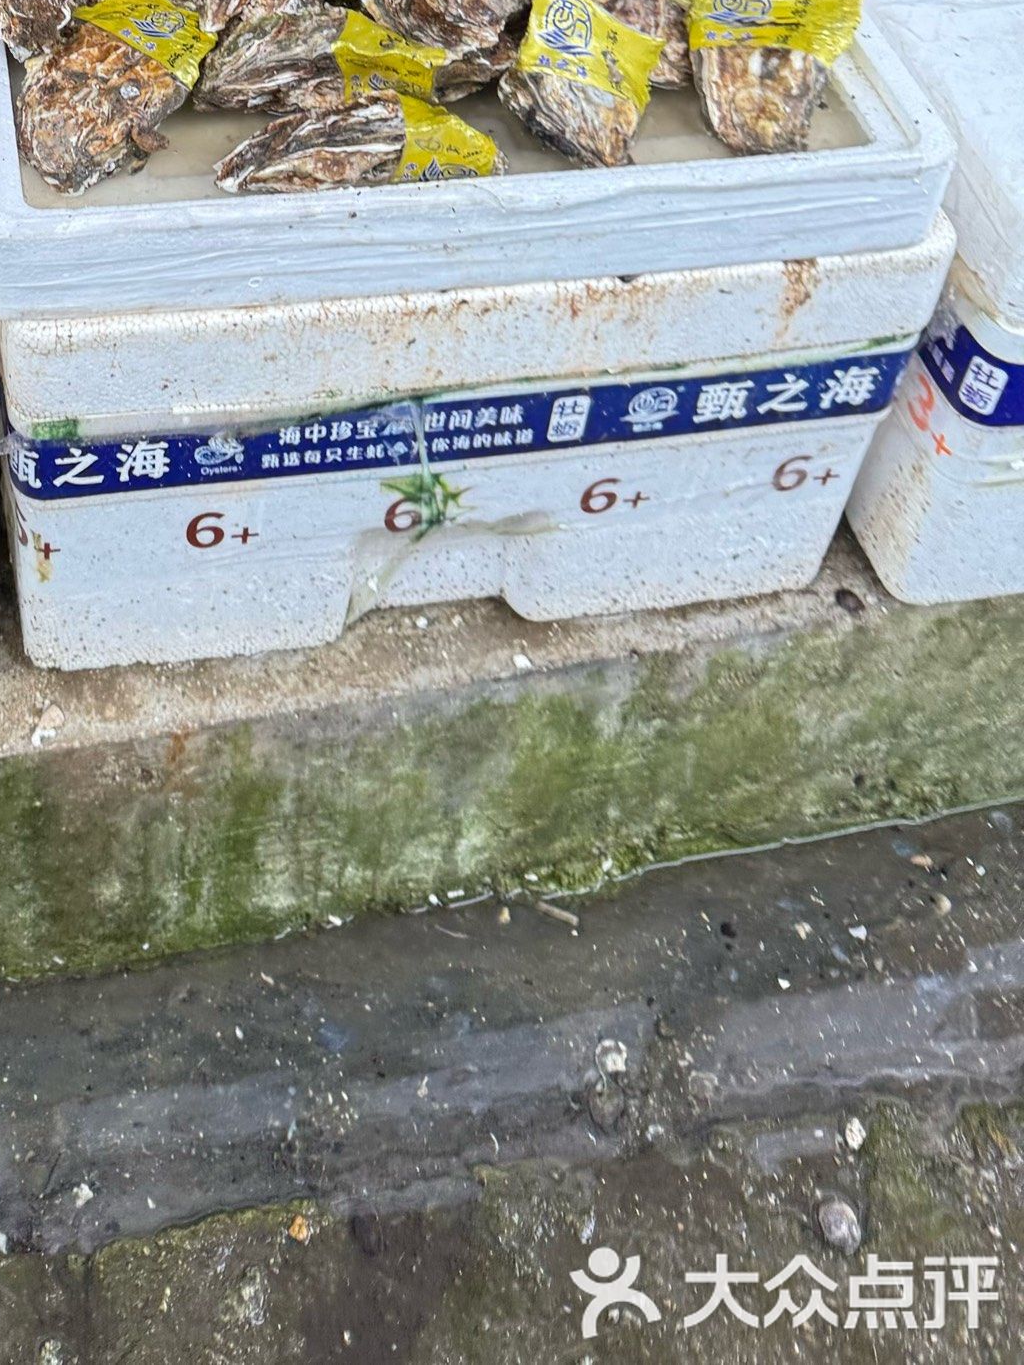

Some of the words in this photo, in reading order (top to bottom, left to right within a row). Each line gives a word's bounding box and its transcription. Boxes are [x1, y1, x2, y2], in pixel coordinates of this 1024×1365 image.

[692, 366, 880, 424] 甄之海
[772, 455, 840, 492] 6+
[580, 477, 650, 515] 6+
[185, 511, 260, 549] 6+
